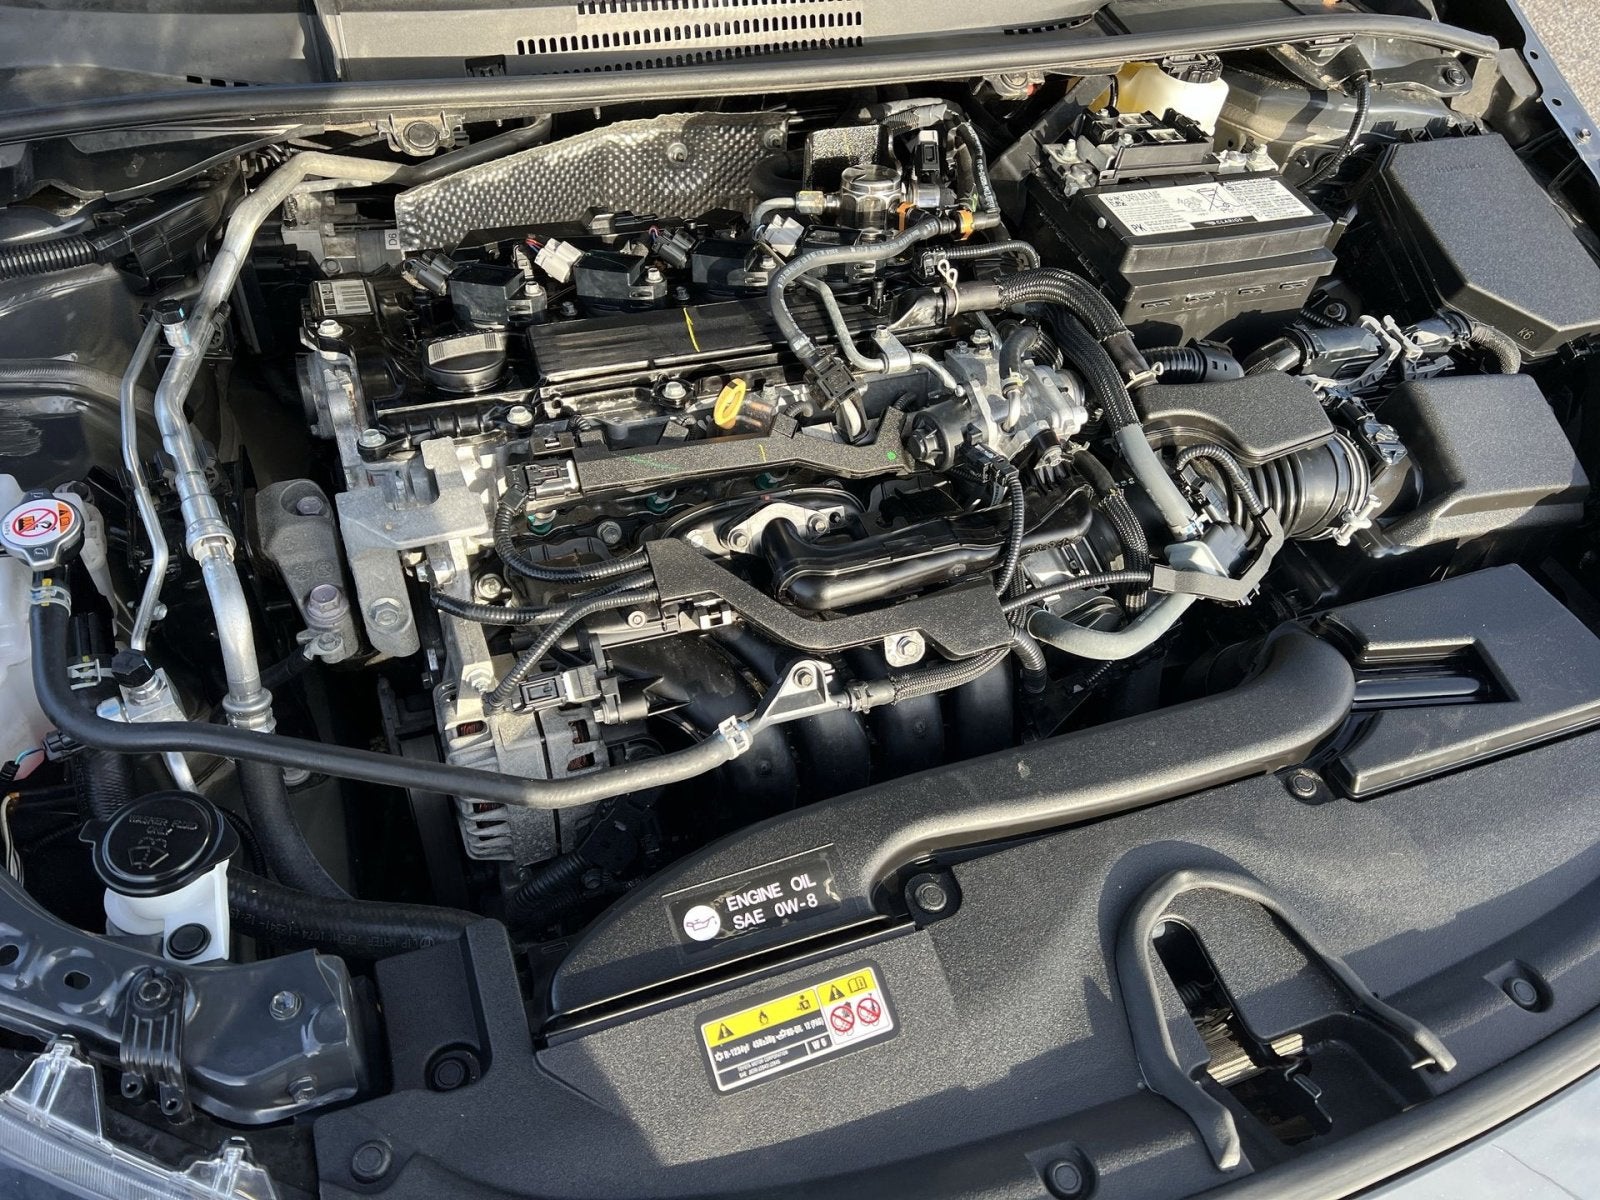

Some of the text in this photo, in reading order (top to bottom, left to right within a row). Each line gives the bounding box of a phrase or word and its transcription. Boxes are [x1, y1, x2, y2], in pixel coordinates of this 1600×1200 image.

[1132, 223, 1147, 233] PK
[1215, 217, 1244, 226] CLARIOS
[725, 873, 817, 912] ENGINE OIL
[732, 893, 818, 930] SAE 0W-8
